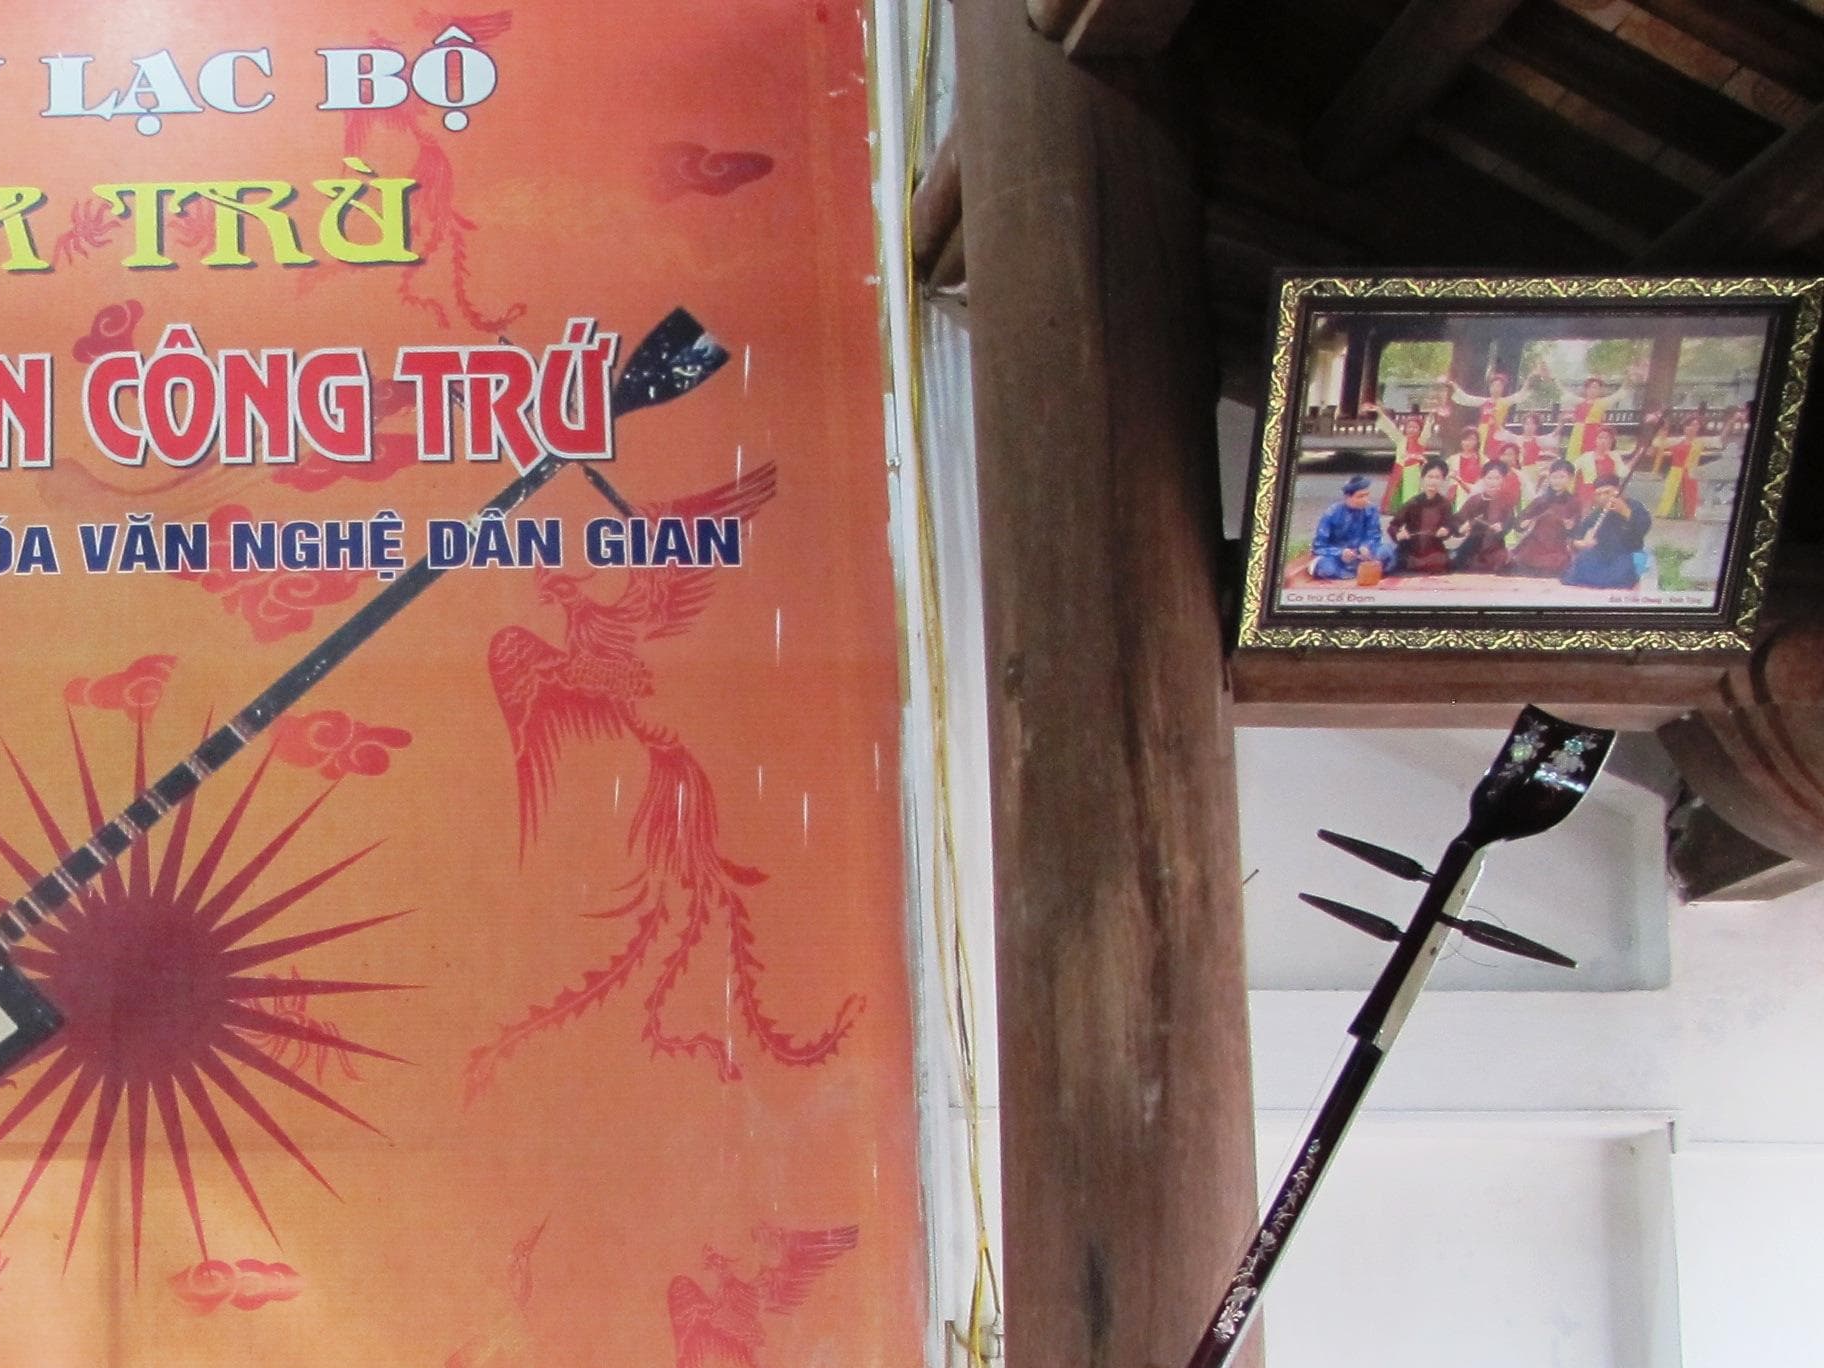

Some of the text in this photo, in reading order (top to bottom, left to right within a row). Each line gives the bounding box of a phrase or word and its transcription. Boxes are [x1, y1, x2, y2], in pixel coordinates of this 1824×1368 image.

[39, 47, 275, 136] LẠC
[315, 24, 498, 132] BỘ
[92, 156, 425, 272] TRÙ
[82, 323, 373, 467] CÔNG
[393, 317, 619, 478] TRỨ
[79, 512, 210, 574] VĂN
[232, 510, 406, 581] NGHỆ
[427, 508, 565, 569] DÂN
[584, 516, 742, 568] GIAN
